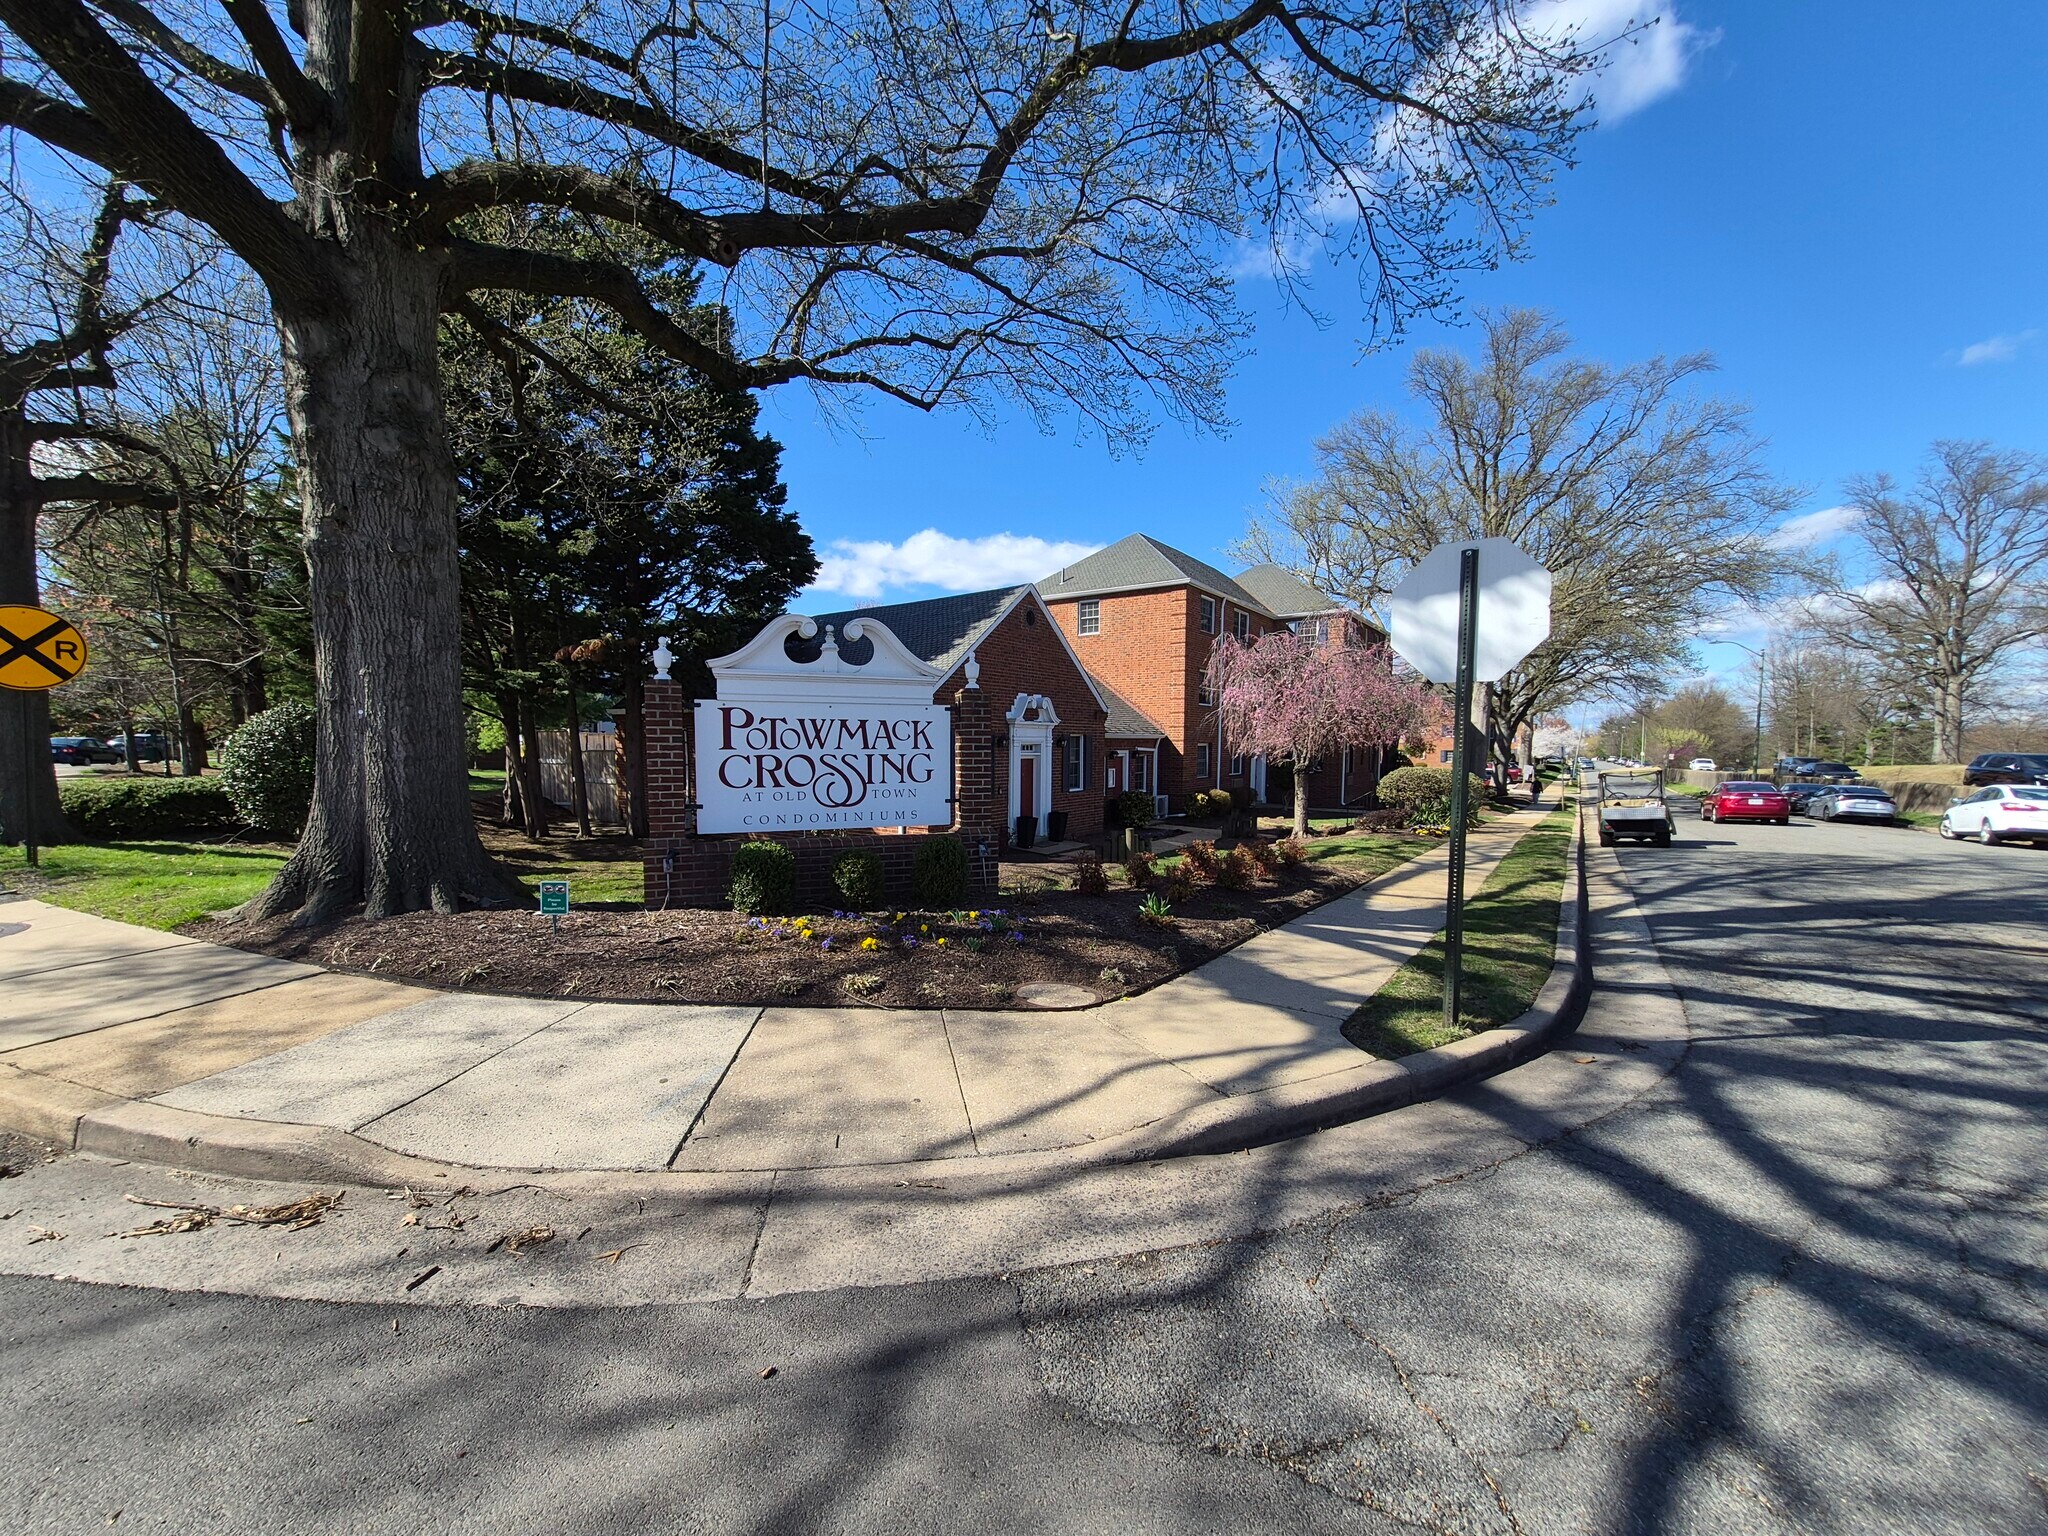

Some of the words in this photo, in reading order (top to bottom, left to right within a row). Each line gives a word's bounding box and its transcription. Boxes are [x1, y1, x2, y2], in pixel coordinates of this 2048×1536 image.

[55, 640, 79, 660] R
[718, 753, 935, 808] CROSSING
[742, 791, 764, 802] AT
[772, 791, 807, 801] OLD
[871, 788, 918, 799] TOWN
[743, 809, 918, 825] CONDOMINIUMS
